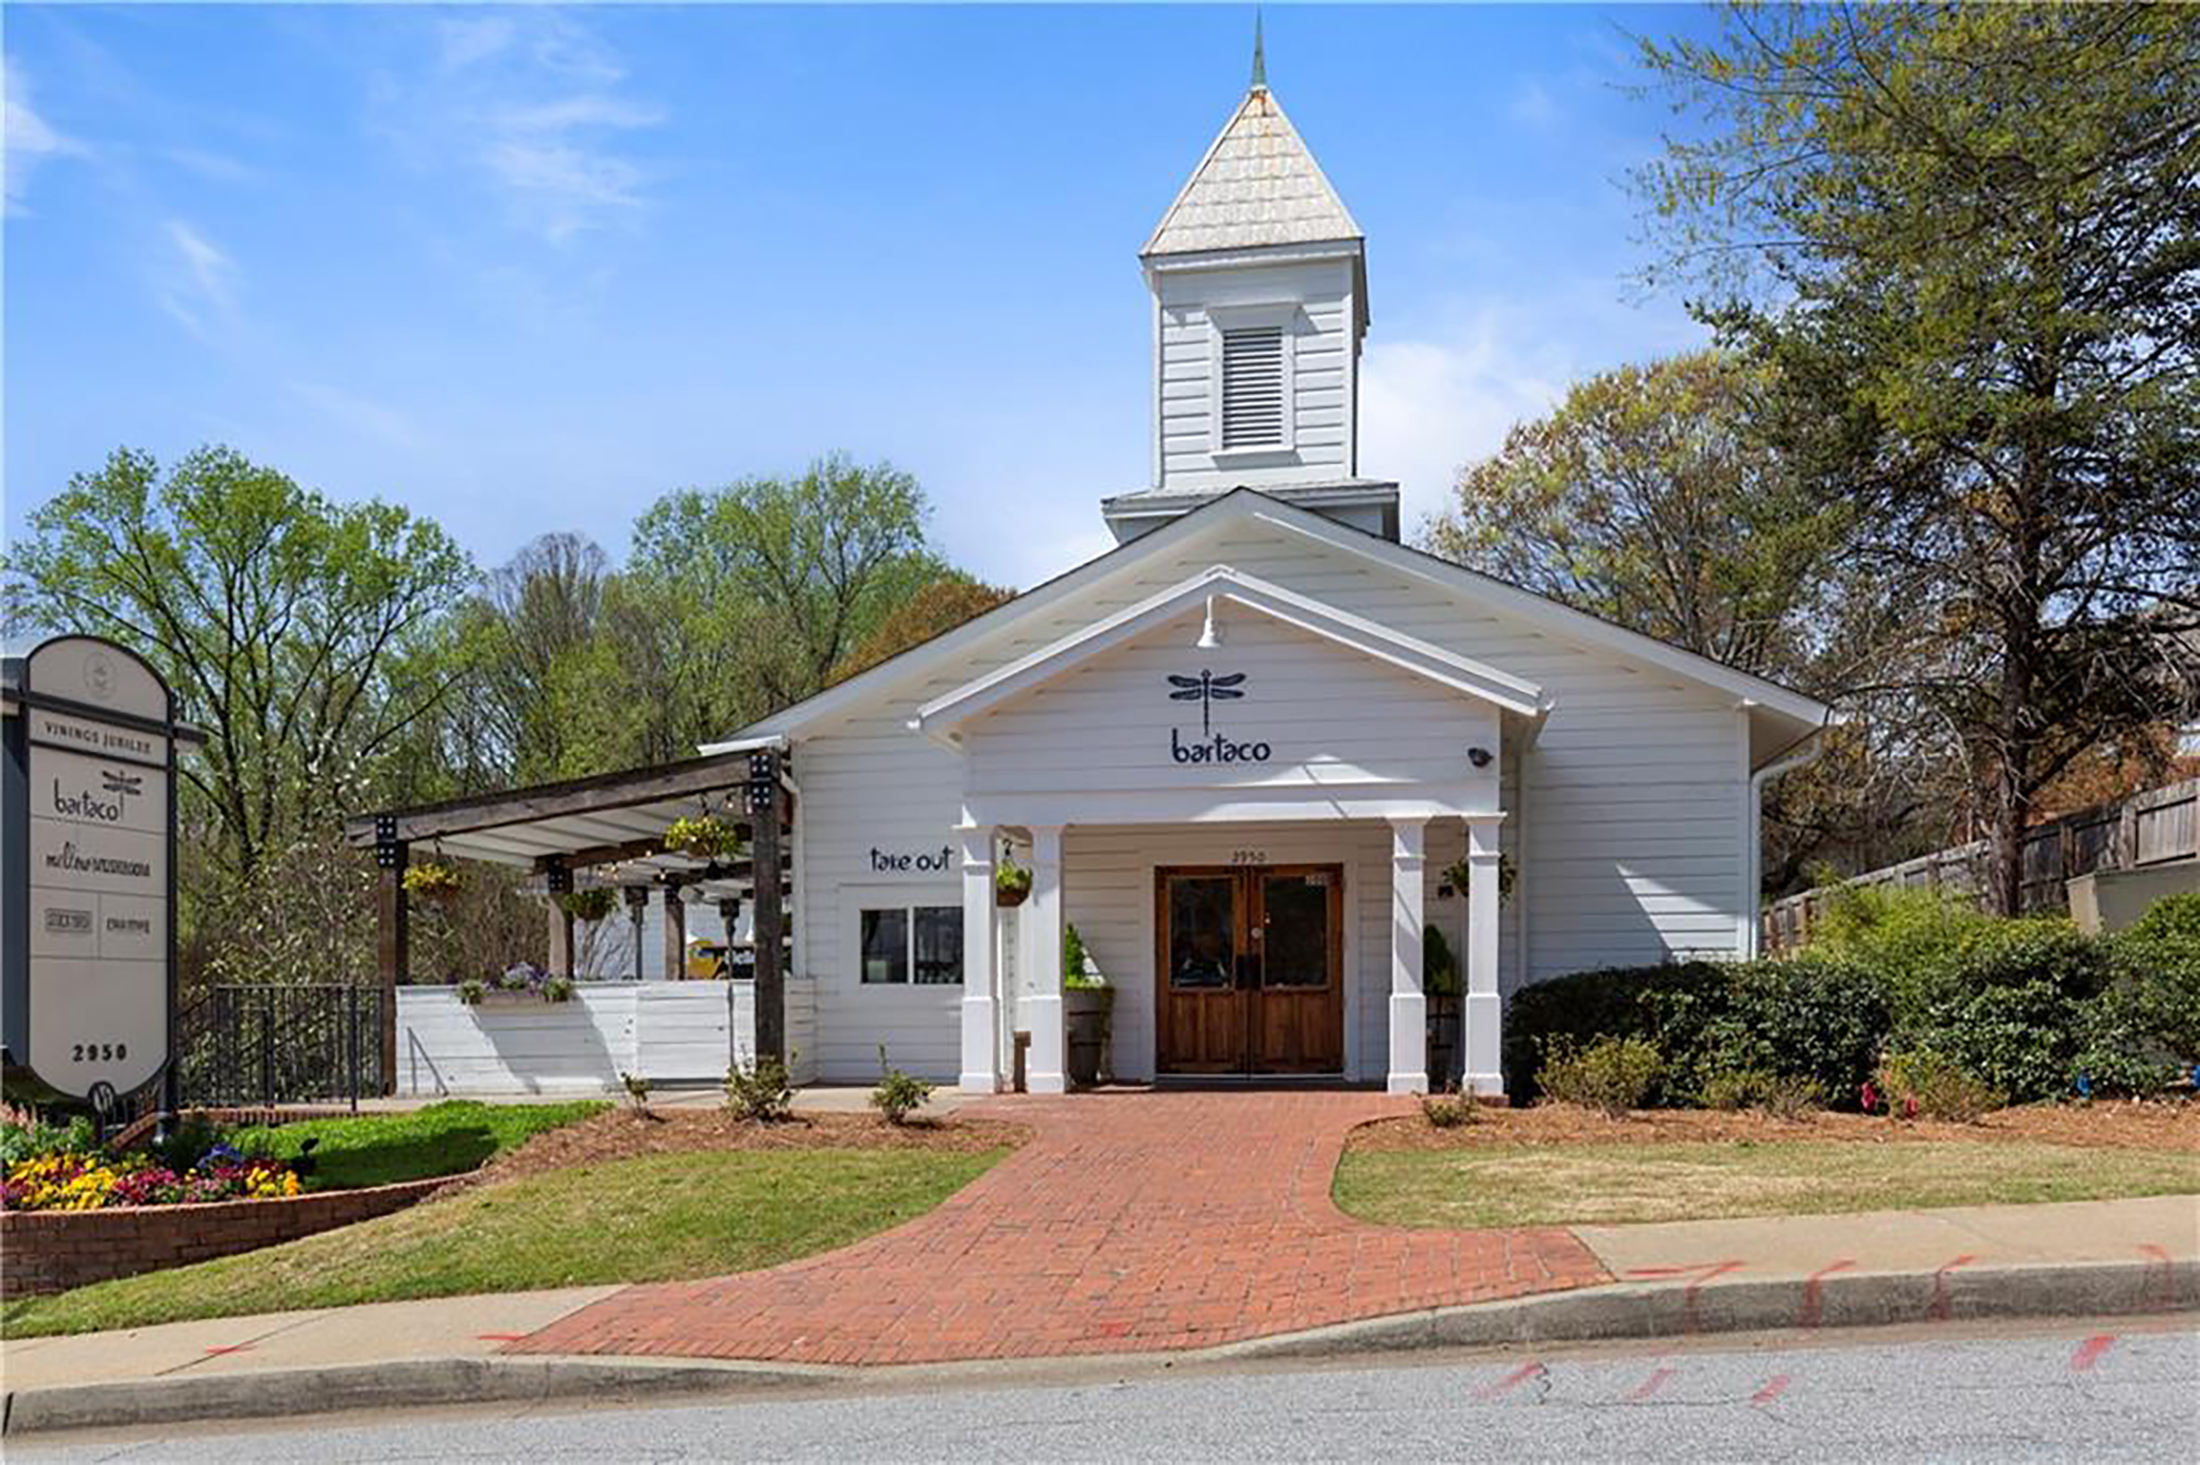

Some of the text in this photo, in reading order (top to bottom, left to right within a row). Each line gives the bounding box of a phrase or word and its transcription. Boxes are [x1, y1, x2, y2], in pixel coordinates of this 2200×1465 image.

[45, 721, 99, 744] VININGS
[1171, 727, 1271, 763] bartaco
[54, 775, 119, 821] bartaco
[870, 845, 954, 872] take out
[73, 1043, 127, 1062] 2950
